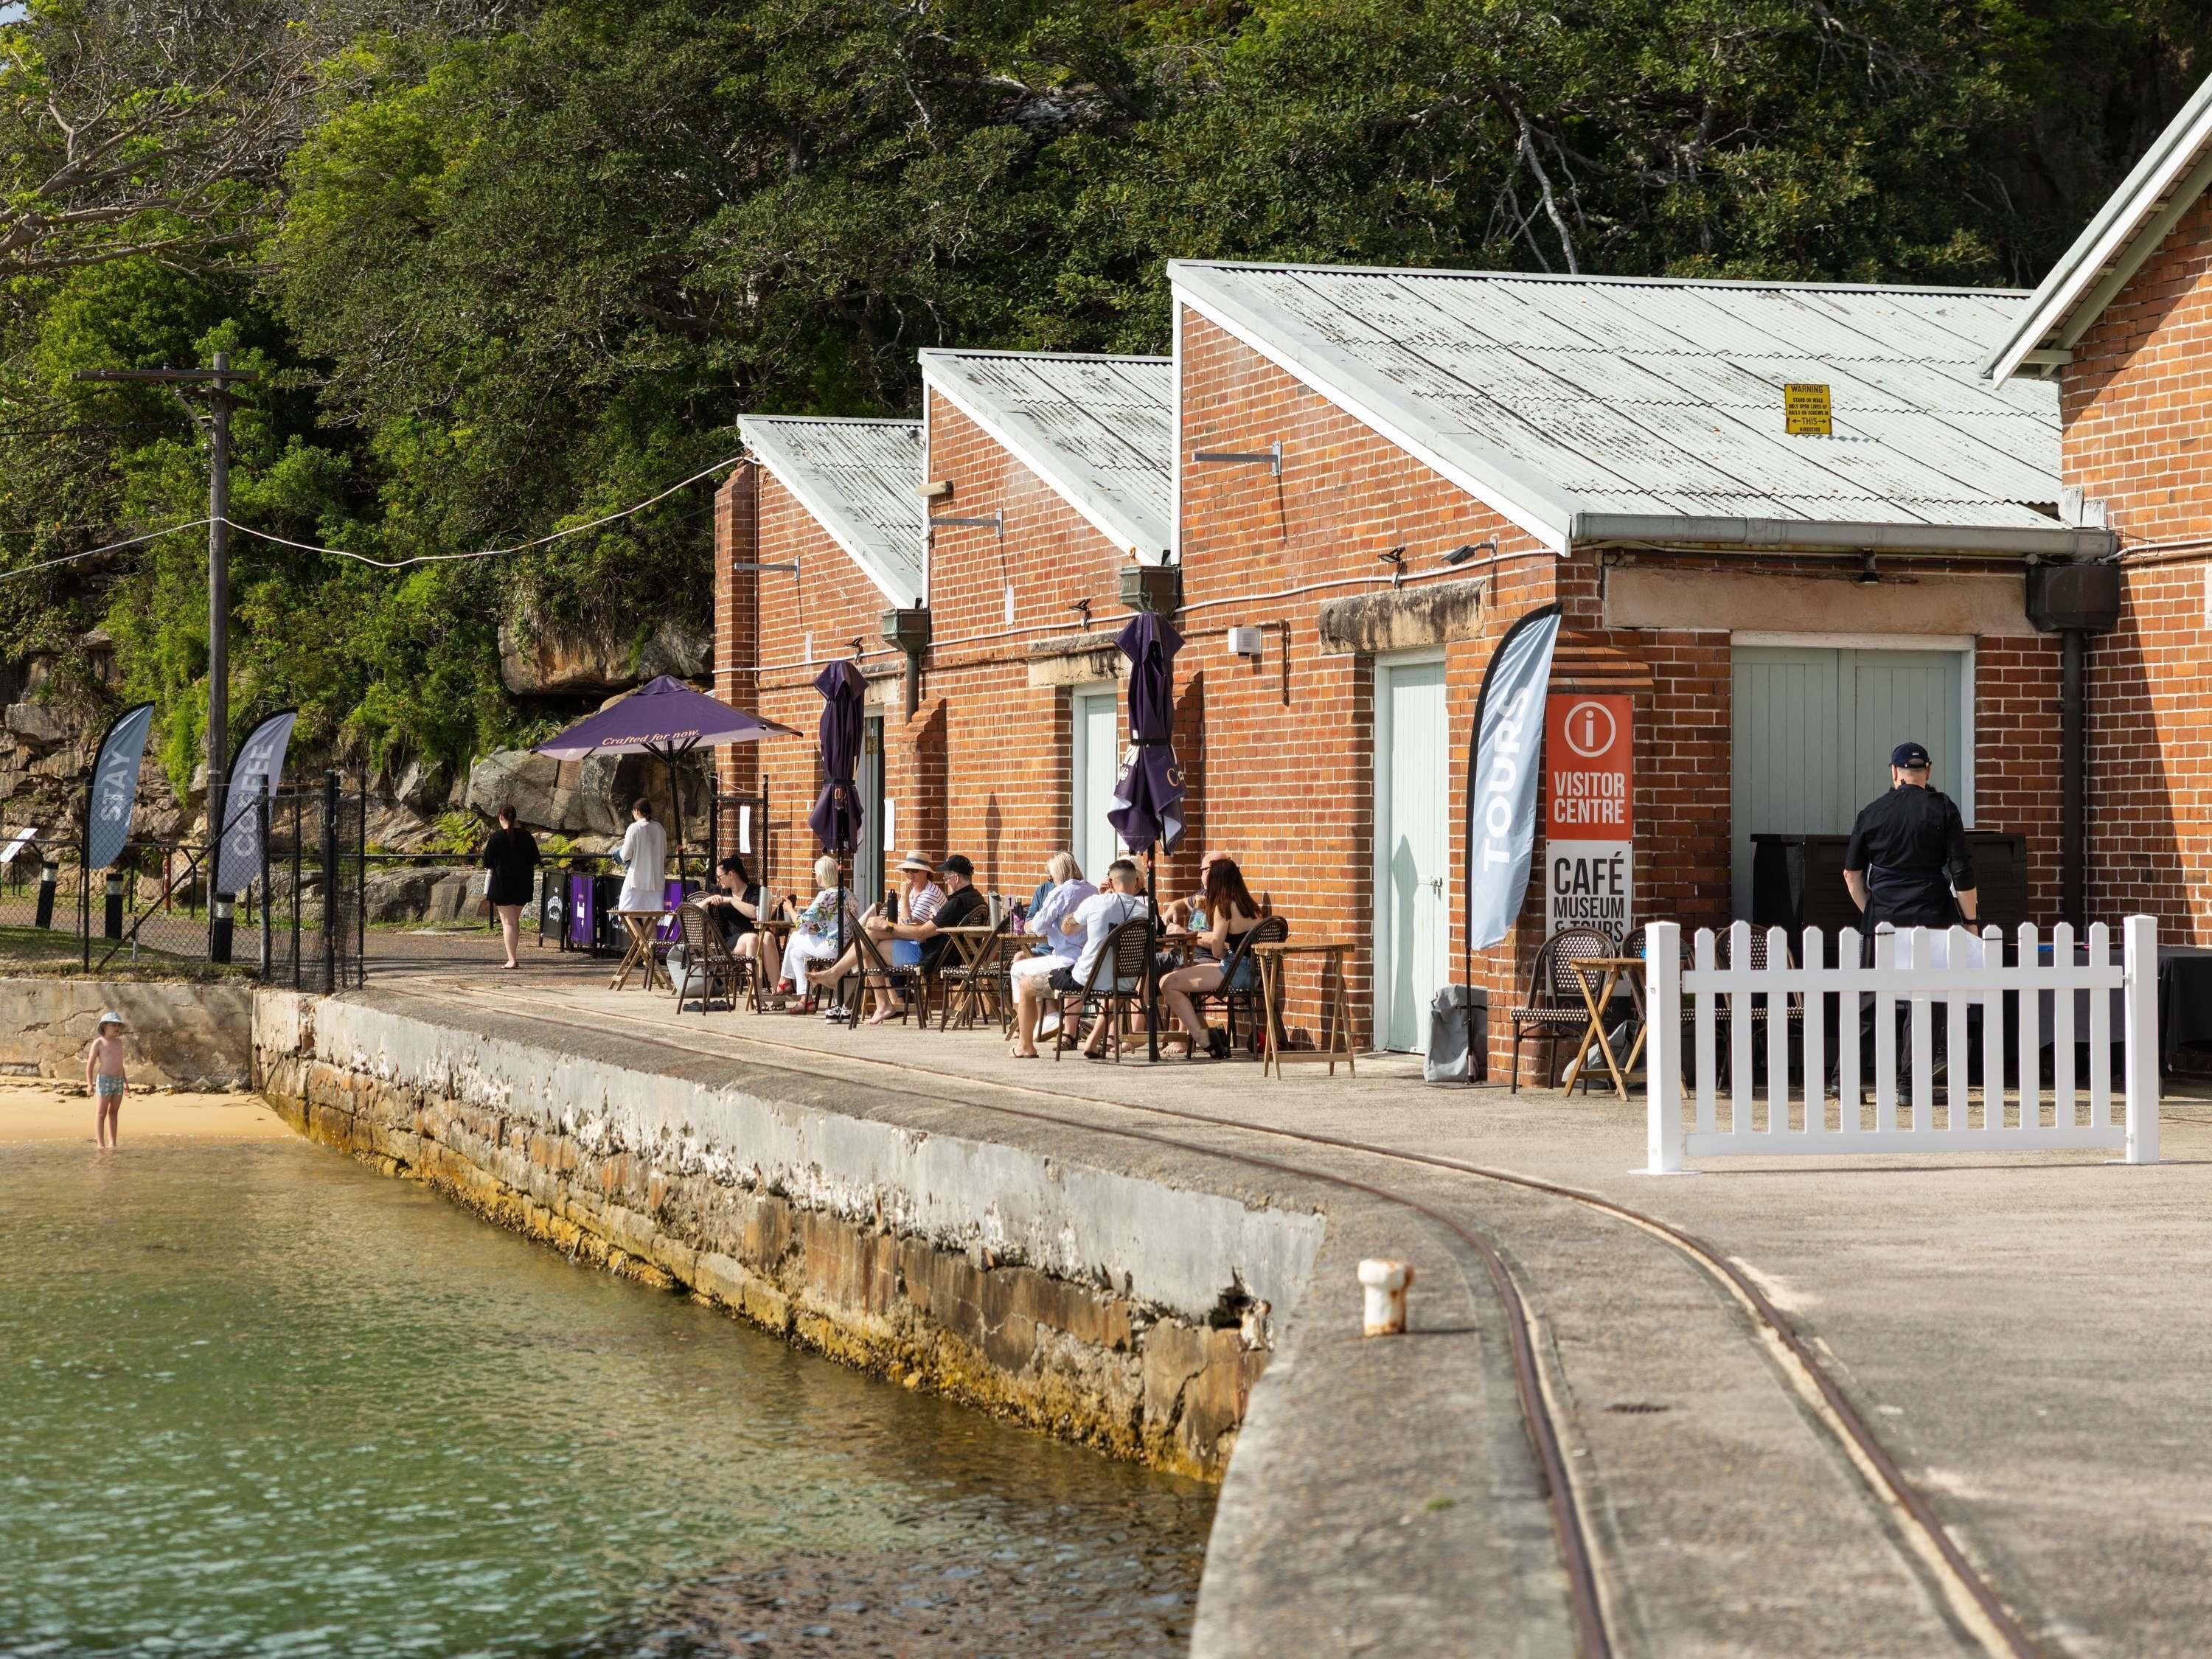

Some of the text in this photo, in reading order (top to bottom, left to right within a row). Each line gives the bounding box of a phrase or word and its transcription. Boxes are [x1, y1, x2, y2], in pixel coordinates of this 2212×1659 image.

[1791, 385, 1823, 393] WARNING
[602, 734, 648, 745] Crafted
[650, 733, 670, 742] for
[100, 749, 131, 822] STAY
[1483, 686, 1529, 872] TOURS
[1554, 771, 1625, 797] VISITOR
[1554, 798, 1625, 824] CENTRE
[1554, 851, 1624, 895] CAFÉ
[1554, 897, 1624, 919] MUSEUM
